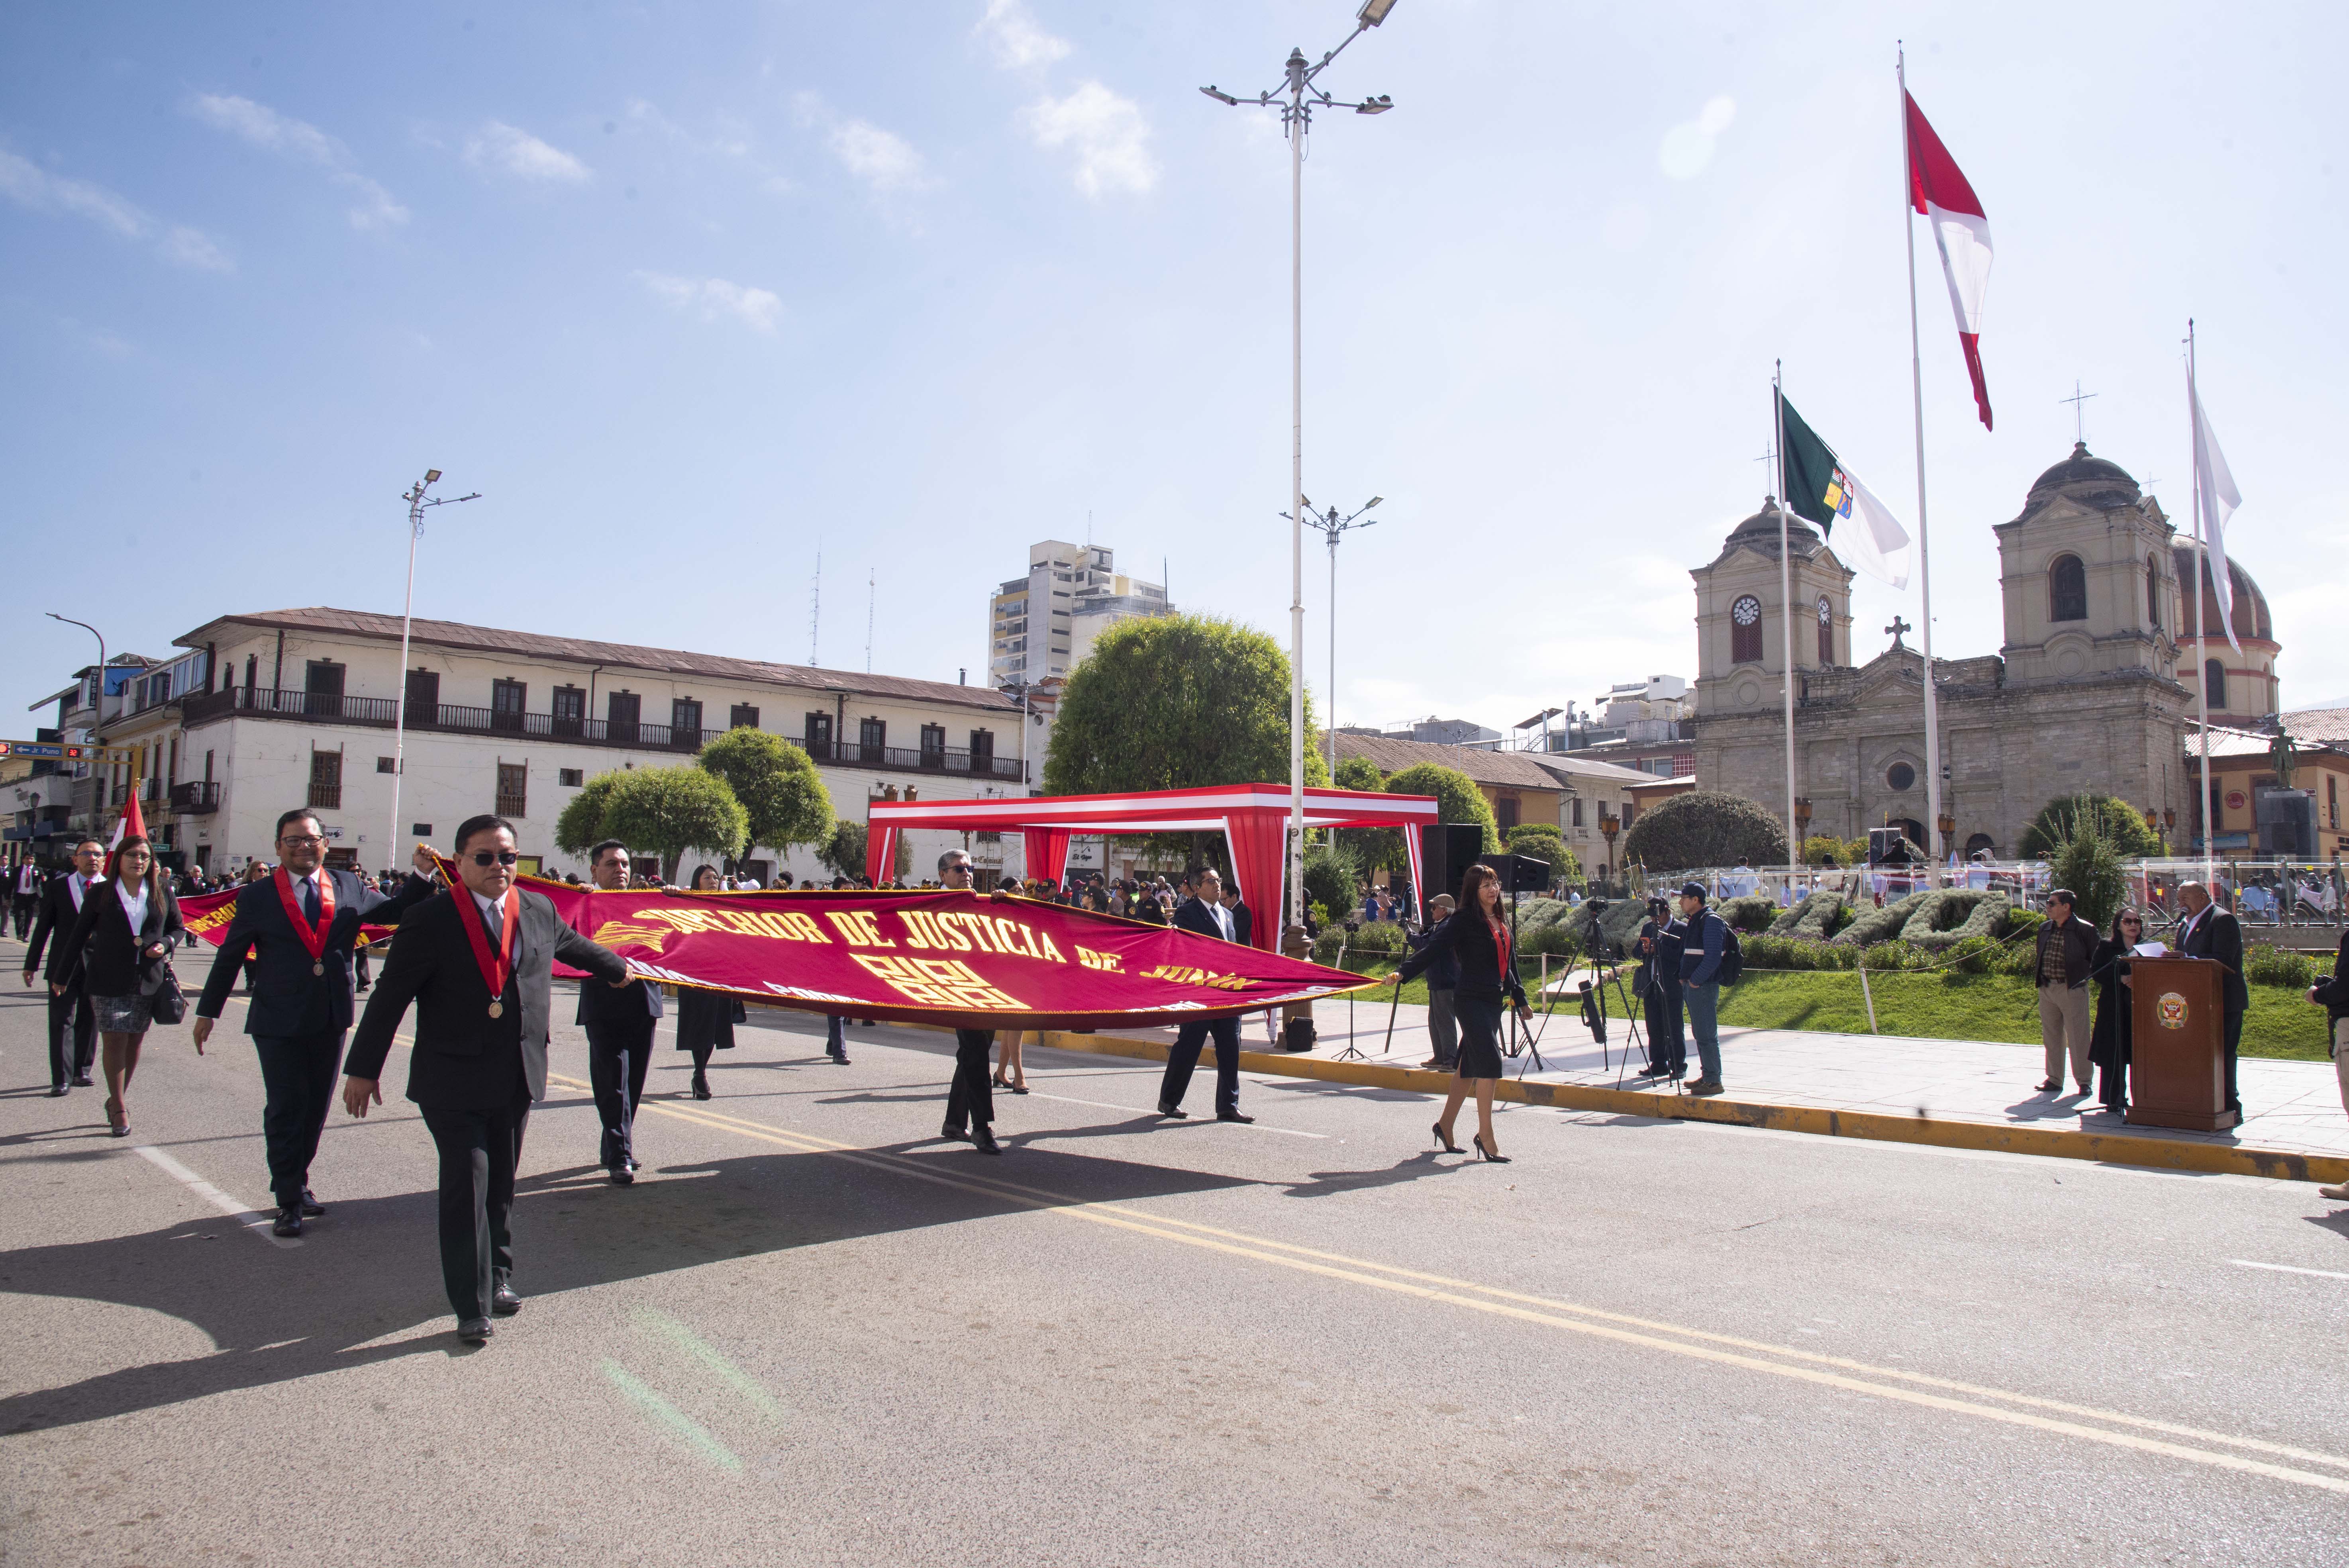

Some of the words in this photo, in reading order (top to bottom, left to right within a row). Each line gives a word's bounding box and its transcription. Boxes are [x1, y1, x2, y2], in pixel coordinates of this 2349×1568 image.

[632, 909, 833, 944] SUPERIOR
[824, 911, 897, 947] DE
[896, 911, 1067, 964] JUSTICIA
[1075, 945, 1125, 974] DE
[1139, 965, 1262, 990] JUNÍN
